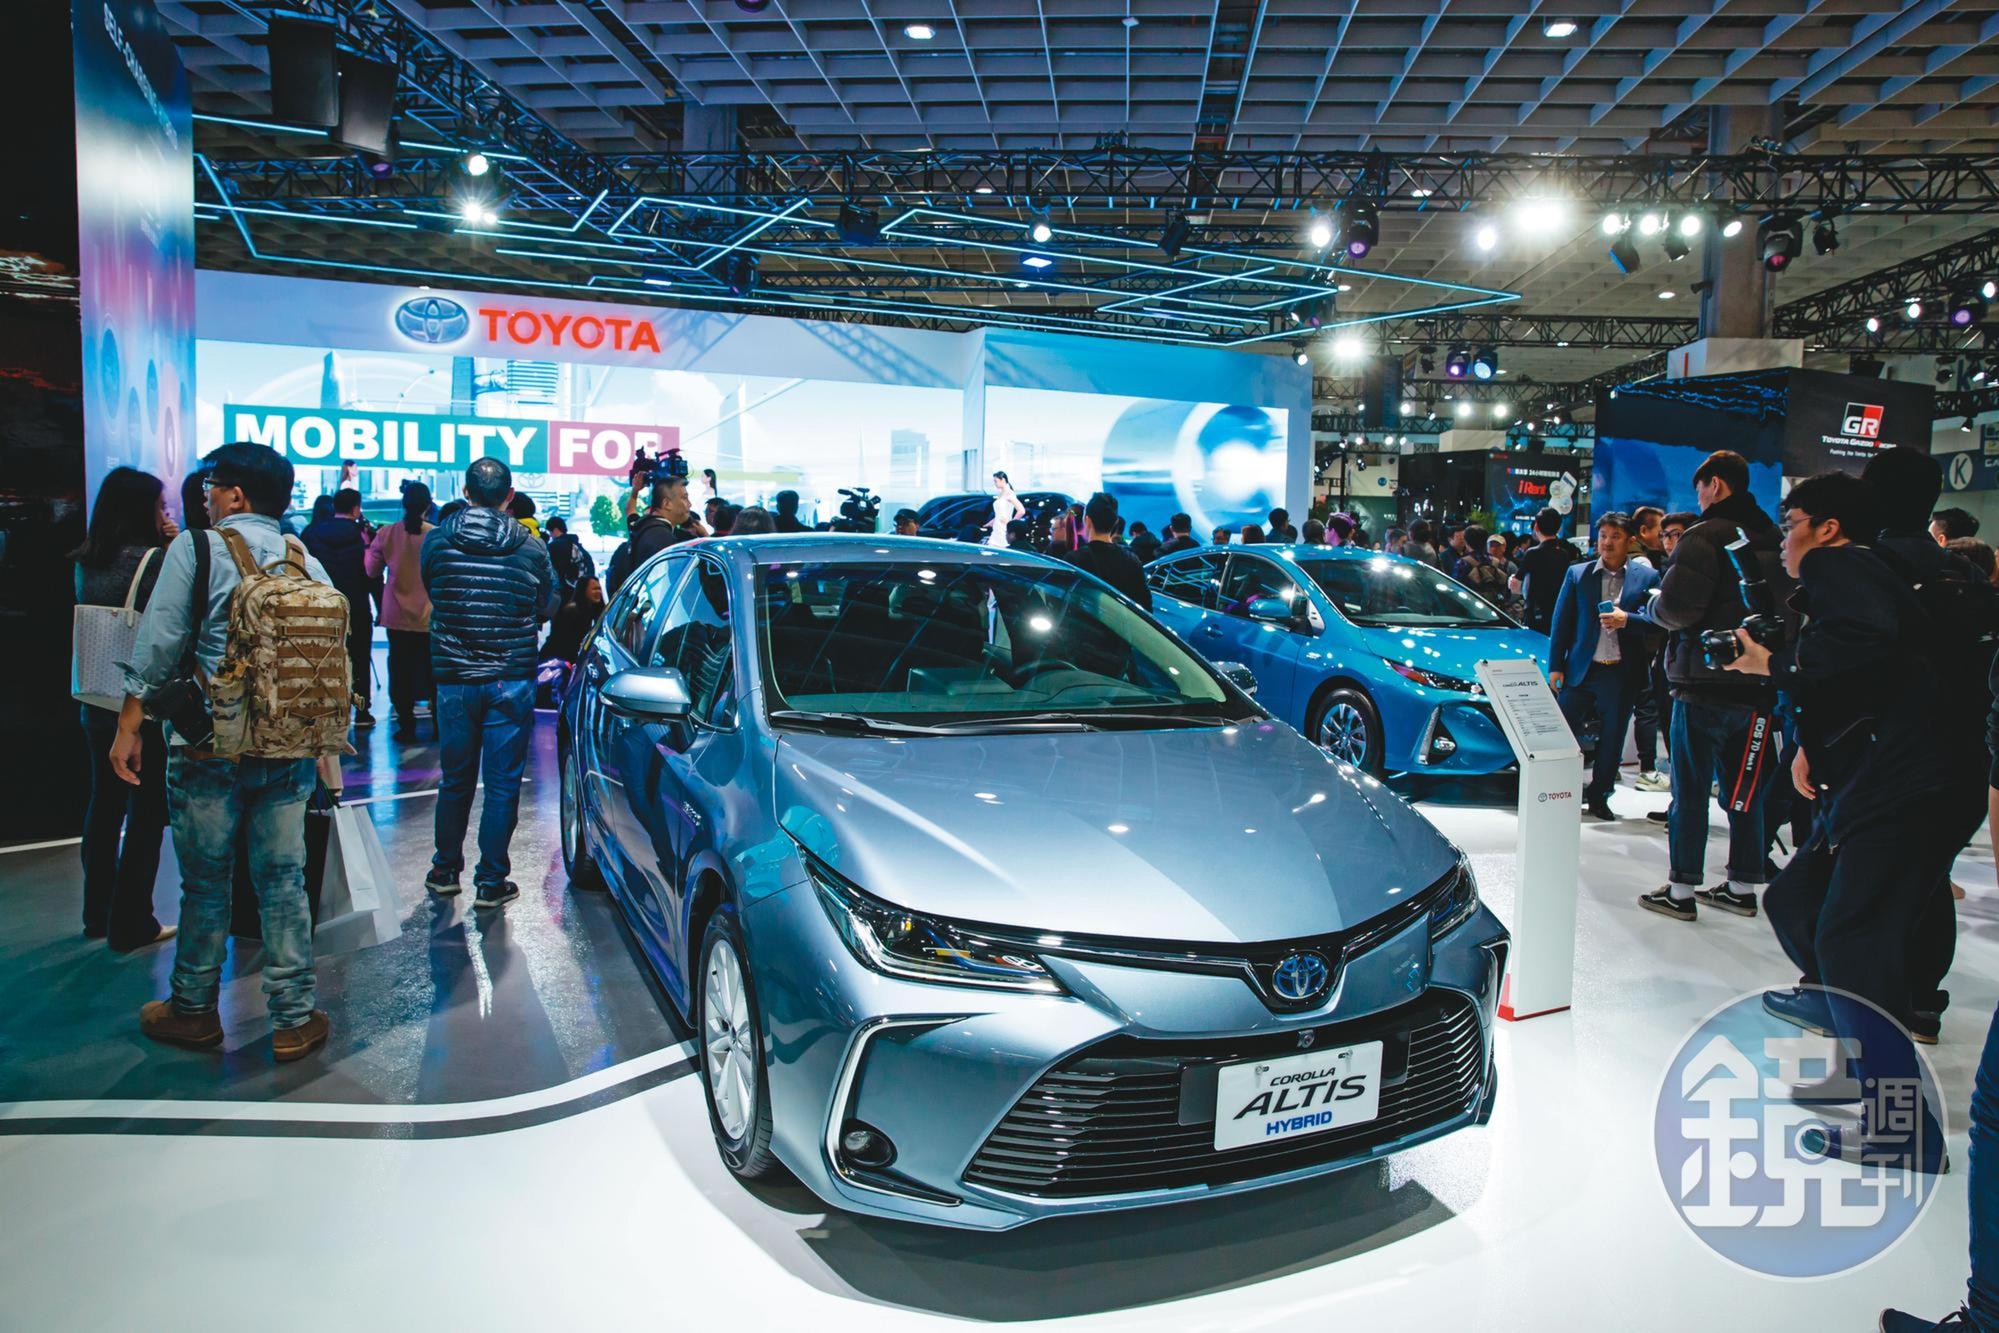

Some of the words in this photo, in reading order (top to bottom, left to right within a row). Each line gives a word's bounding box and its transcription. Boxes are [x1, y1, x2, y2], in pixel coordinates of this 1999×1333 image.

[479, 309, 661, 353] TOYOTA
[1843, 416, 1880, 436] GR
[235, 413, 538, 467] MOBILITY
[1822, 435, 1849, 446] TOYOTA
[1953, 458, 1969, 485] K
[1753, 717, 1766, 739] EOS
[1548, 792, 1572, 800] TOYOTA
[1269, 1067, 1337, 1087] COROLLA
[1232, 1074, 1367, 1120] ALTIS
[1266, 1110, 1333, 1136] HYBRID
